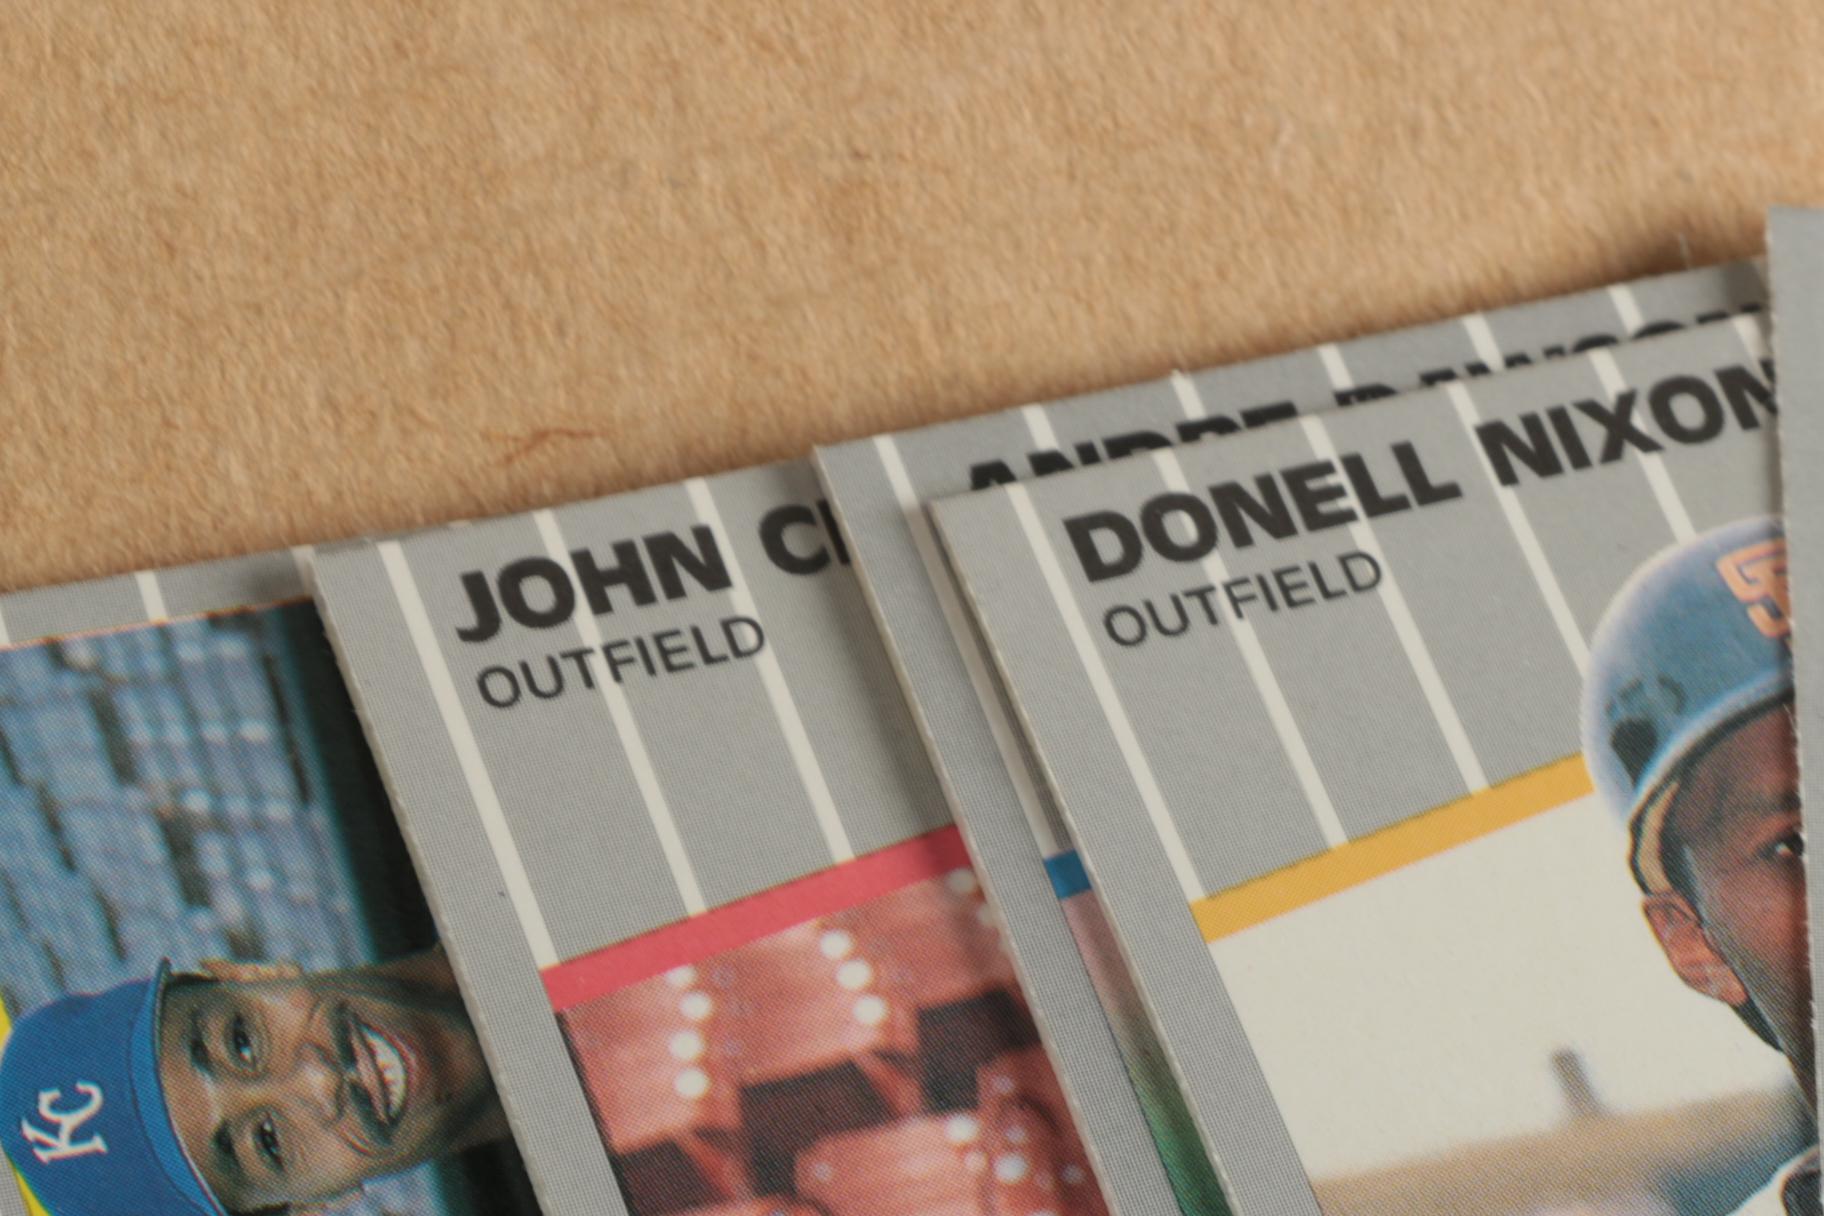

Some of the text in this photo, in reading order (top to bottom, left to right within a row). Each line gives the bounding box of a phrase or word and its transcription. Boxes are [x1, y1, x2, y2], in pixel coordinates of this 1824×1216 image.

[1062, 441, 1463, 584] DONELL
[1475, 357, 1777, 487] NIXON
[456, 525, 733, 644] JOHN
[1102, 550, 1383, 648] OUTFIELD
[475, 615, 766, 710] OUTFIELD
[21, 1079, 108, 1165] KC
